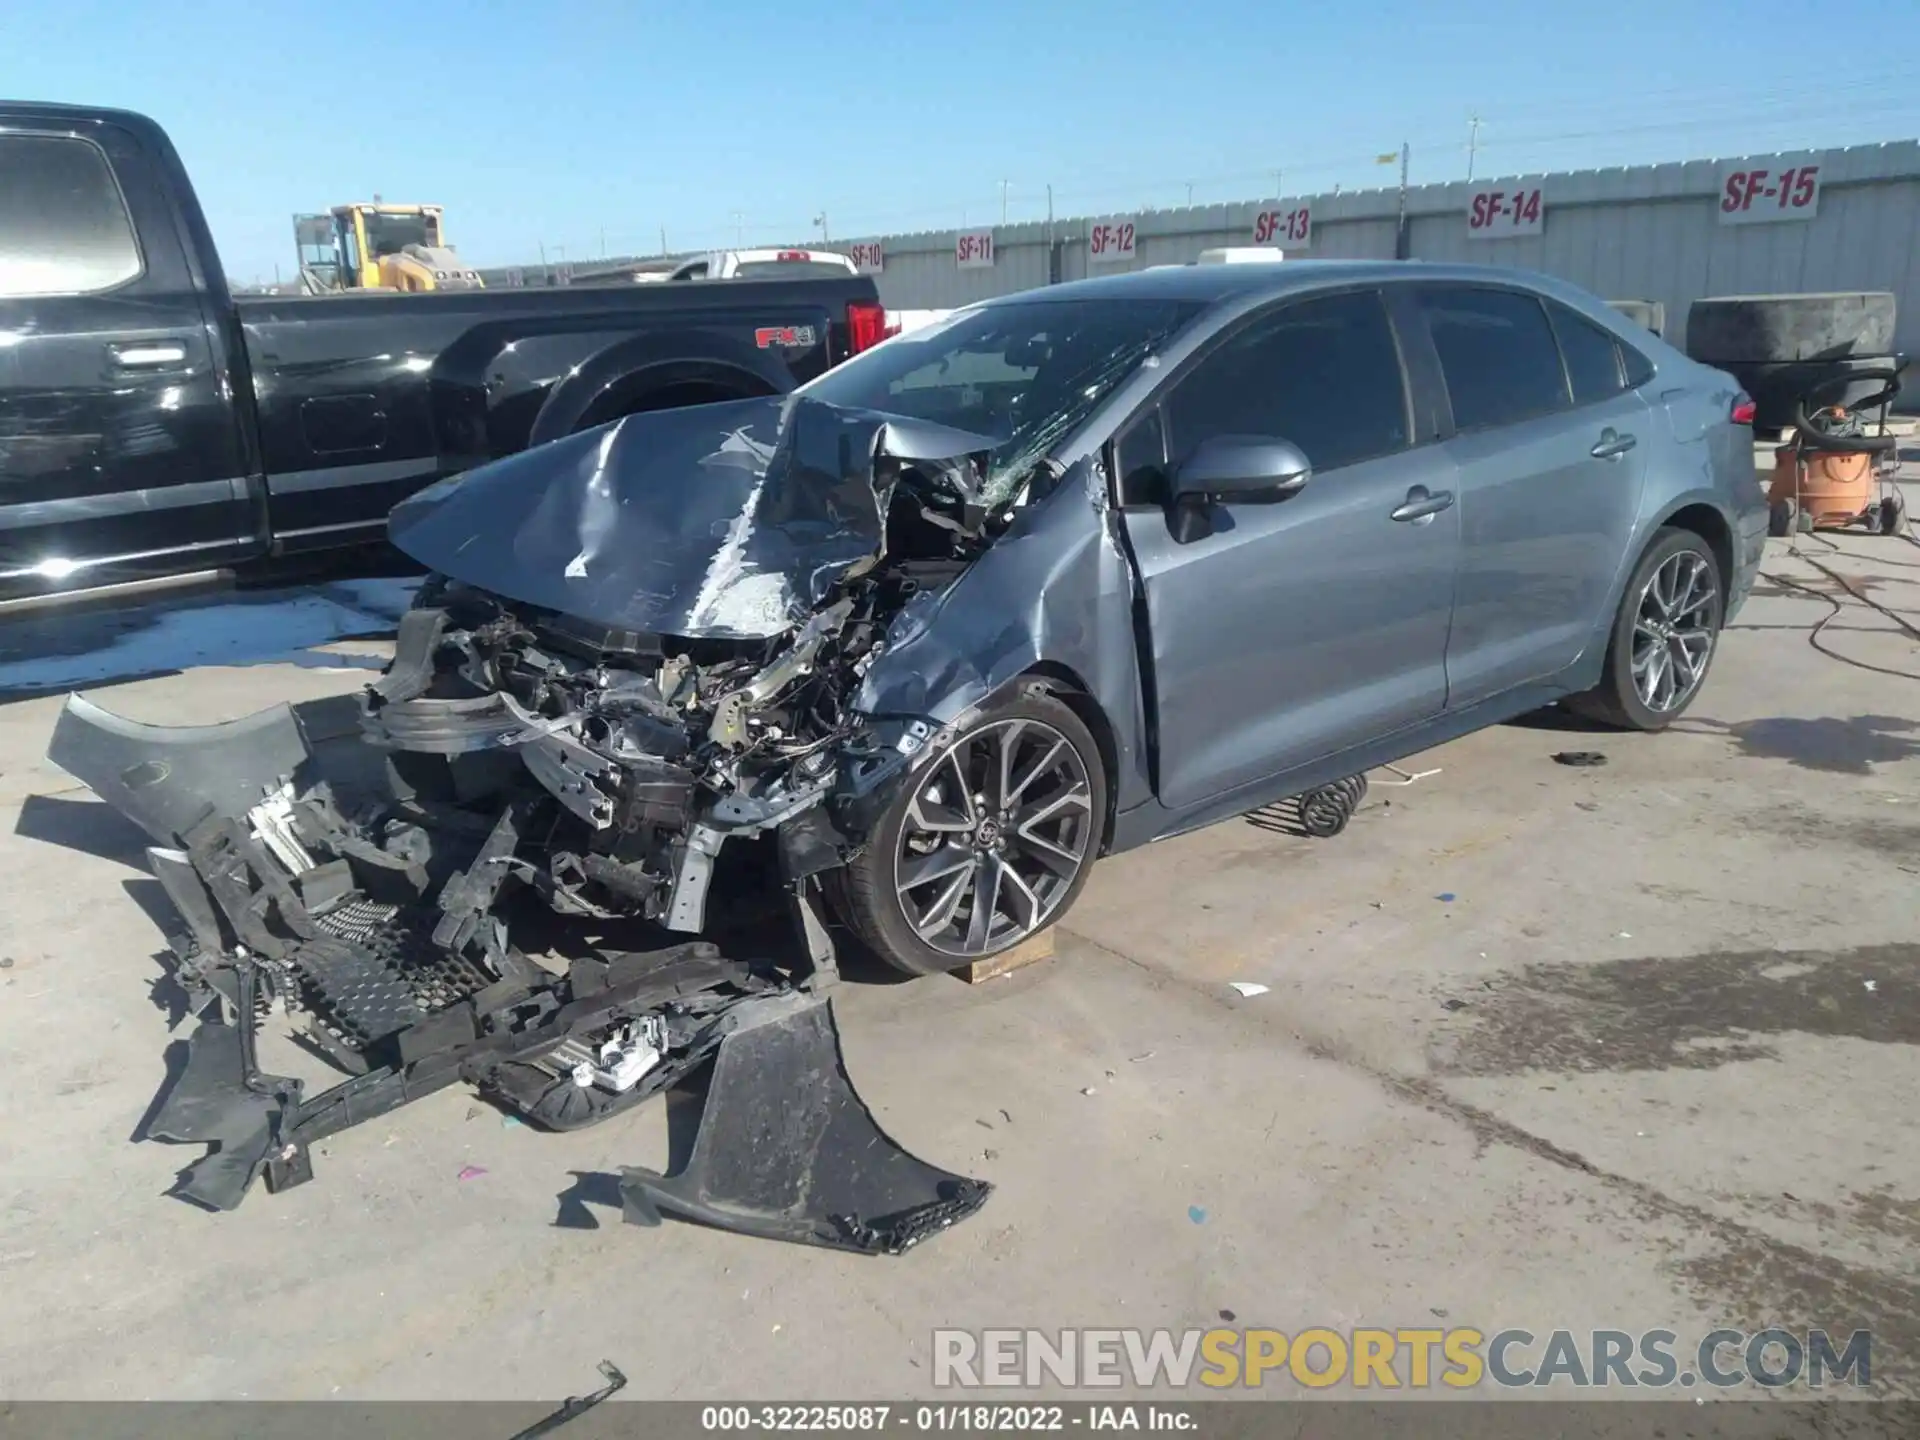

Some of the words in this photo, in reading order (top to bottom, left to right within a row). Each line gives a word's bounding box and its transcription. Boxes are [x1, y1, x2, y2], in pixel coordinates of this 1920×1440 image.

[1720, 166, 1820, 214] SF-15
[1255, 208, 1310, 243] SF-13
[1470, 189, 1542, 229] SF-14
[851, 243, 881, 267] SF-10
[958, 235, 991, 262] SF-11
[1091, 223, 1134, 254] SF-12
